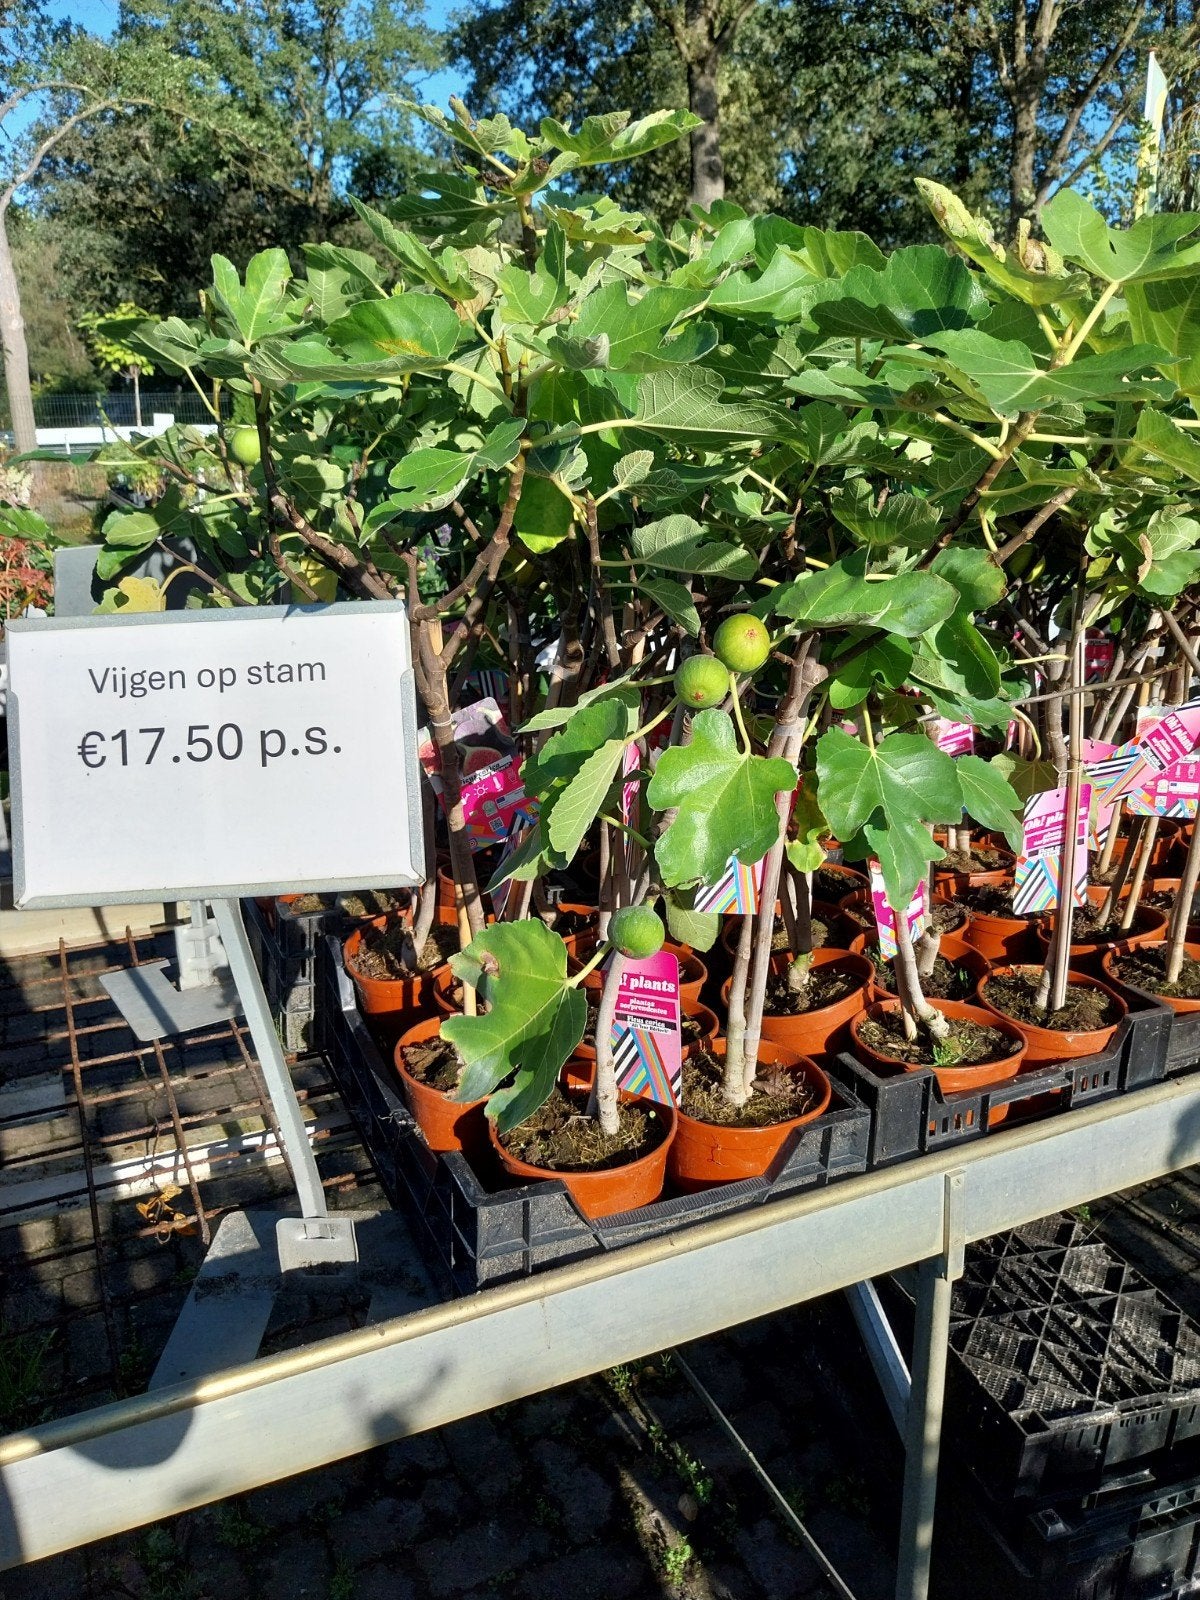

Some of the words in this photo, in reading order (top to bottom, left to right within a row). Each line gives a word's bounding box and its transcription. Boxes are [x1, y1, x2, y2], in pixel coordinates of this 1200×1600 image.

[89, 667, 185, 698] Vijgen
[198, 668, 236, 693] op
[248, 662, 325, 684] stam
[78, 723, 242, 768] €17.50
[261, 727, 341, 767] p.s.
[629, 975, 676, 993] plants
